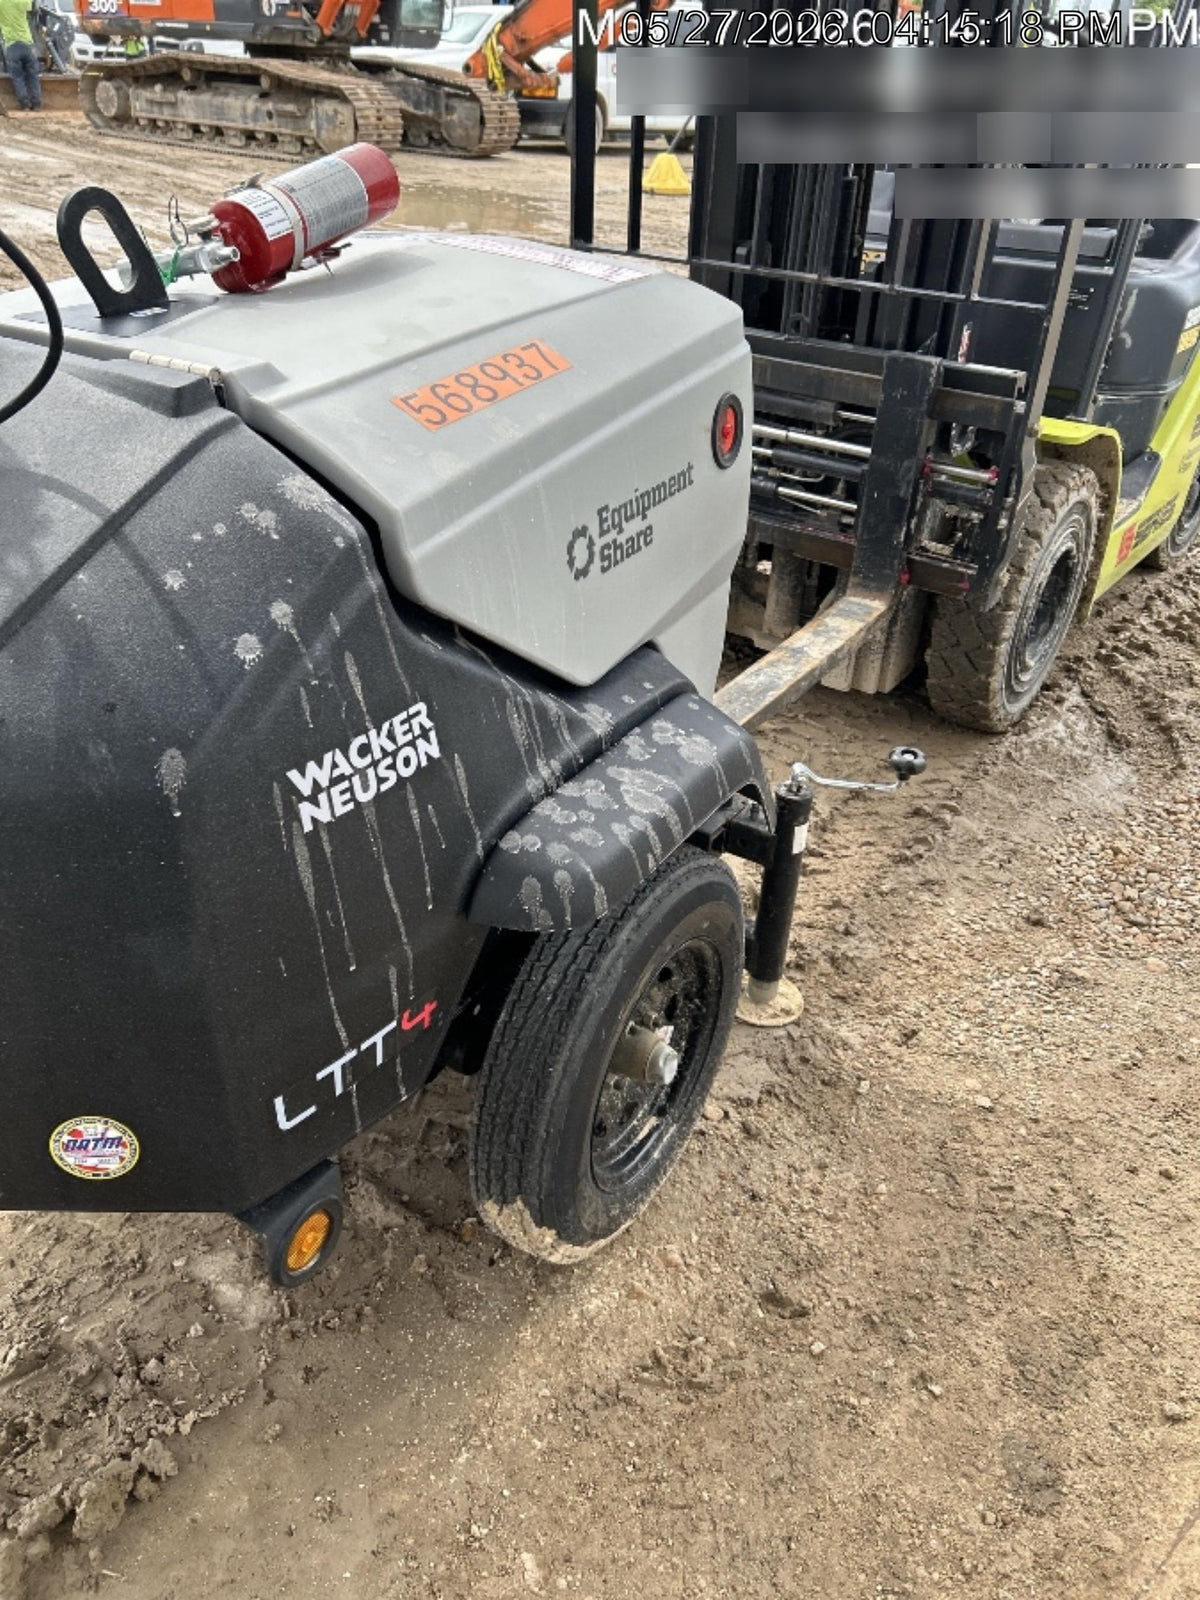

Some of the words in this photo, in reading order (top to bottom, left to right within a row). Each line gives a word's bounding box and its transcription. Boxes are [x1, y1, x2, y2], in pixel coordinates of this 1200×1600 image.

[399, 342, 559, 426] 568937
[597, 462, 695, 537] Equipment
[600, 524, 654, 575] Share
[286, 702, 434, 797] WACKER
[298, 730, 441, 834] NEUSON
